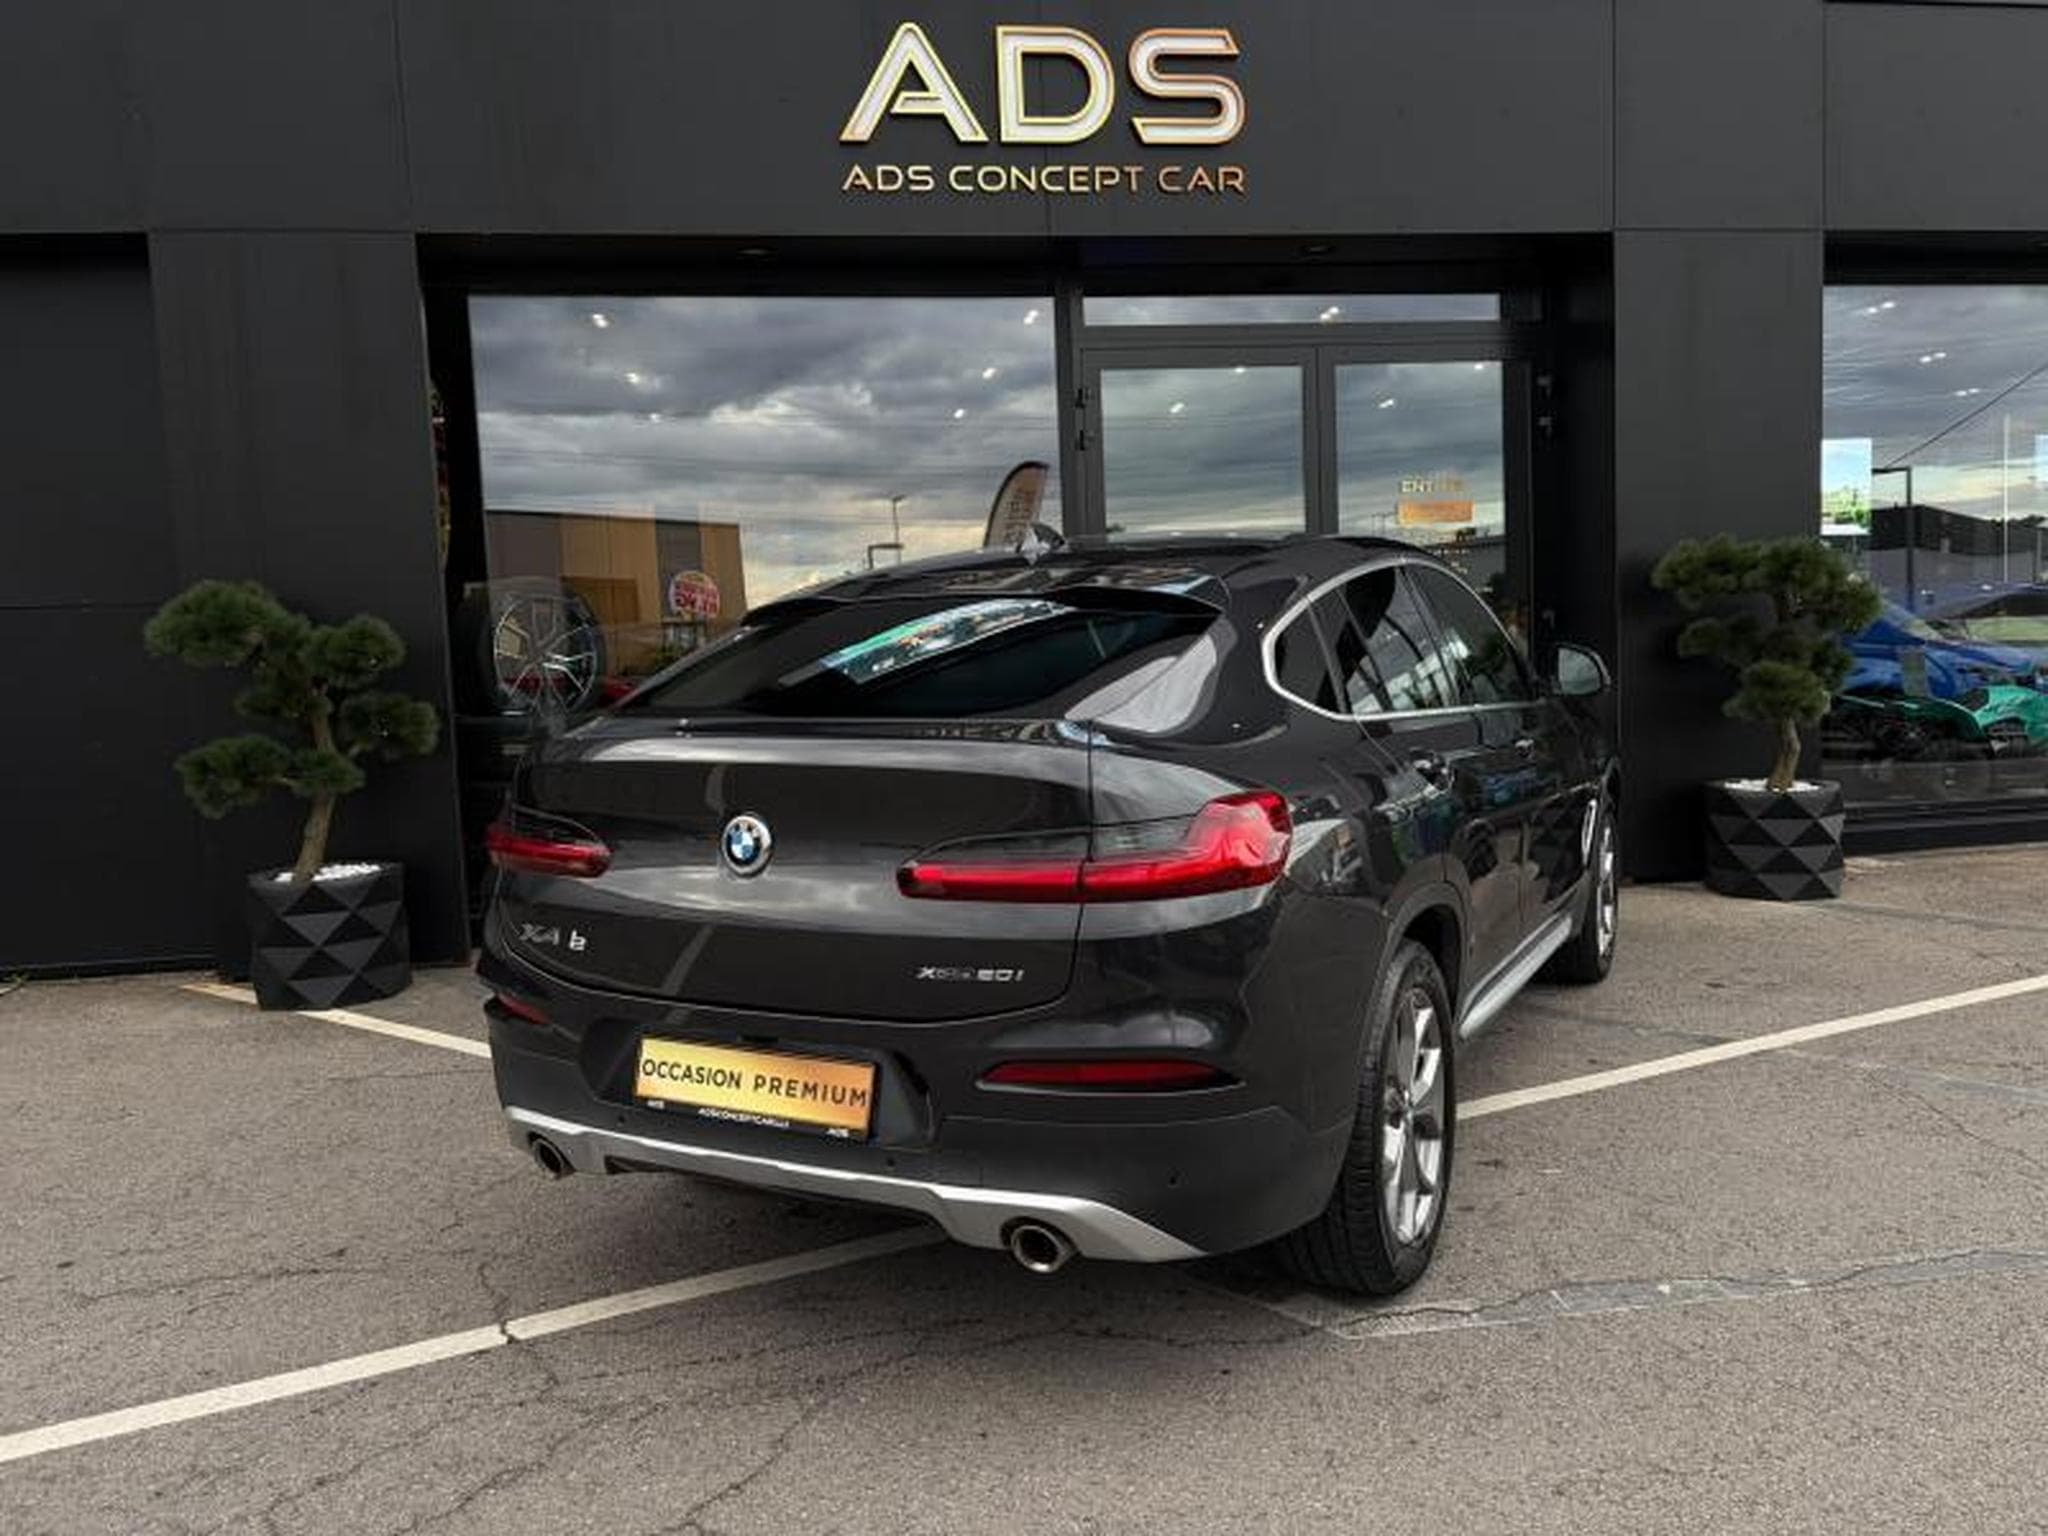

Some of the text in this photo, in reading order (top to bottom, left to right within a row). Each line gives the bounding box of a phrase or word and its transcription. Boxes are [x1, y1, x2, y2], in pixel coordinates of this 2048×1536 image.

[839, 21, 1247, 144] ADS
[841, 163, 1247, 193] ADS CONCEPT CAR
[641, 1058, 868, 1107] OCCASION PREMIUM
